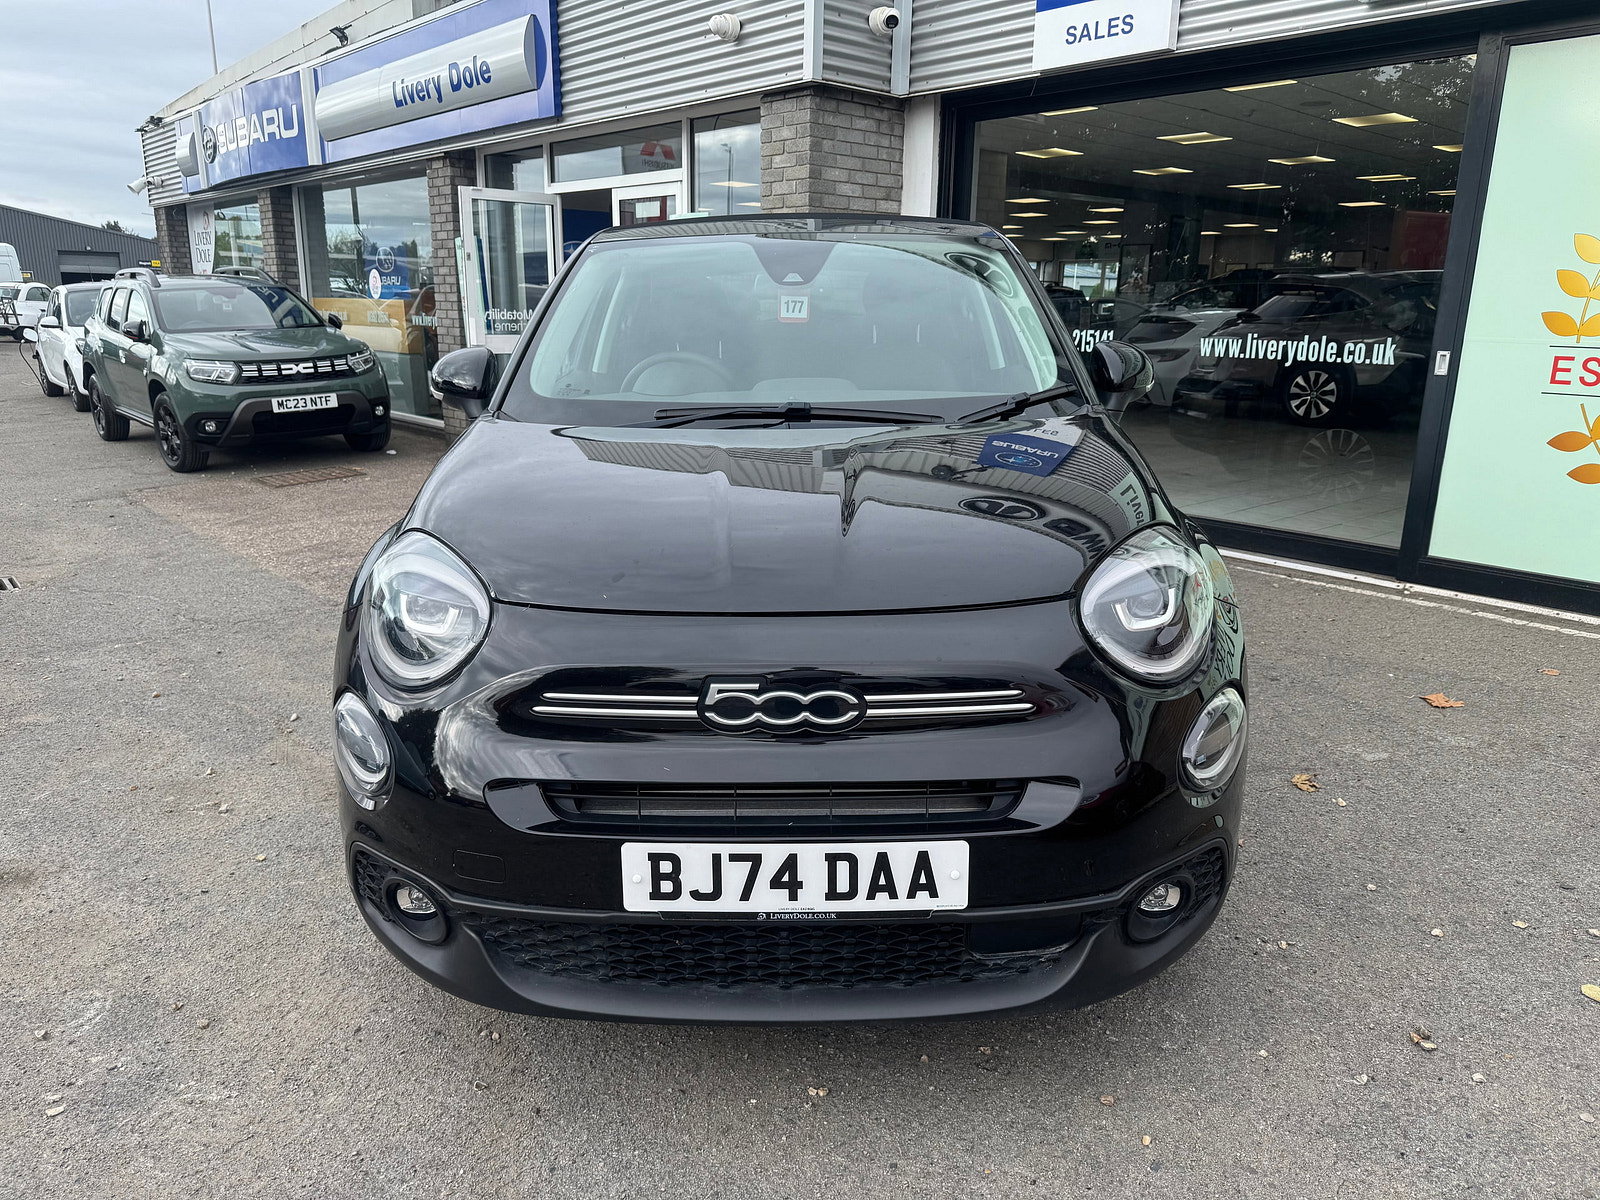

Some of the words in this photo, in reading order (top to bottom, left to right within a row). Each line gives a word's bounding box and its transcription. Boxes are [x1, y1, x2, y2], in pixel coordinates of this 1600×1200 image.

[1065, 14, 1134, 45] SALES
[392, 74, 443, 108] Livery
[448, 55, 492, 93] Dole
[216, 104, 299, 154] SUBARU
[194, 230, 212, 246] LIVERY
[196, 247, 212, 264] DOLE
[381, 275, 401, 286] BARU
[784, 299, 805, 313] 177
[1200, 333, 1397, 367] www.liverydole.co.uk
[1549, 355, 1600, 387] ES
[277, 397, 308, 411] MC23
[310, 395, 331, 408] NTF
[704, 683, 859, 726] 500
[647, 852, 804, 902] BJ74
[824, 850, 940, 902] DAA
